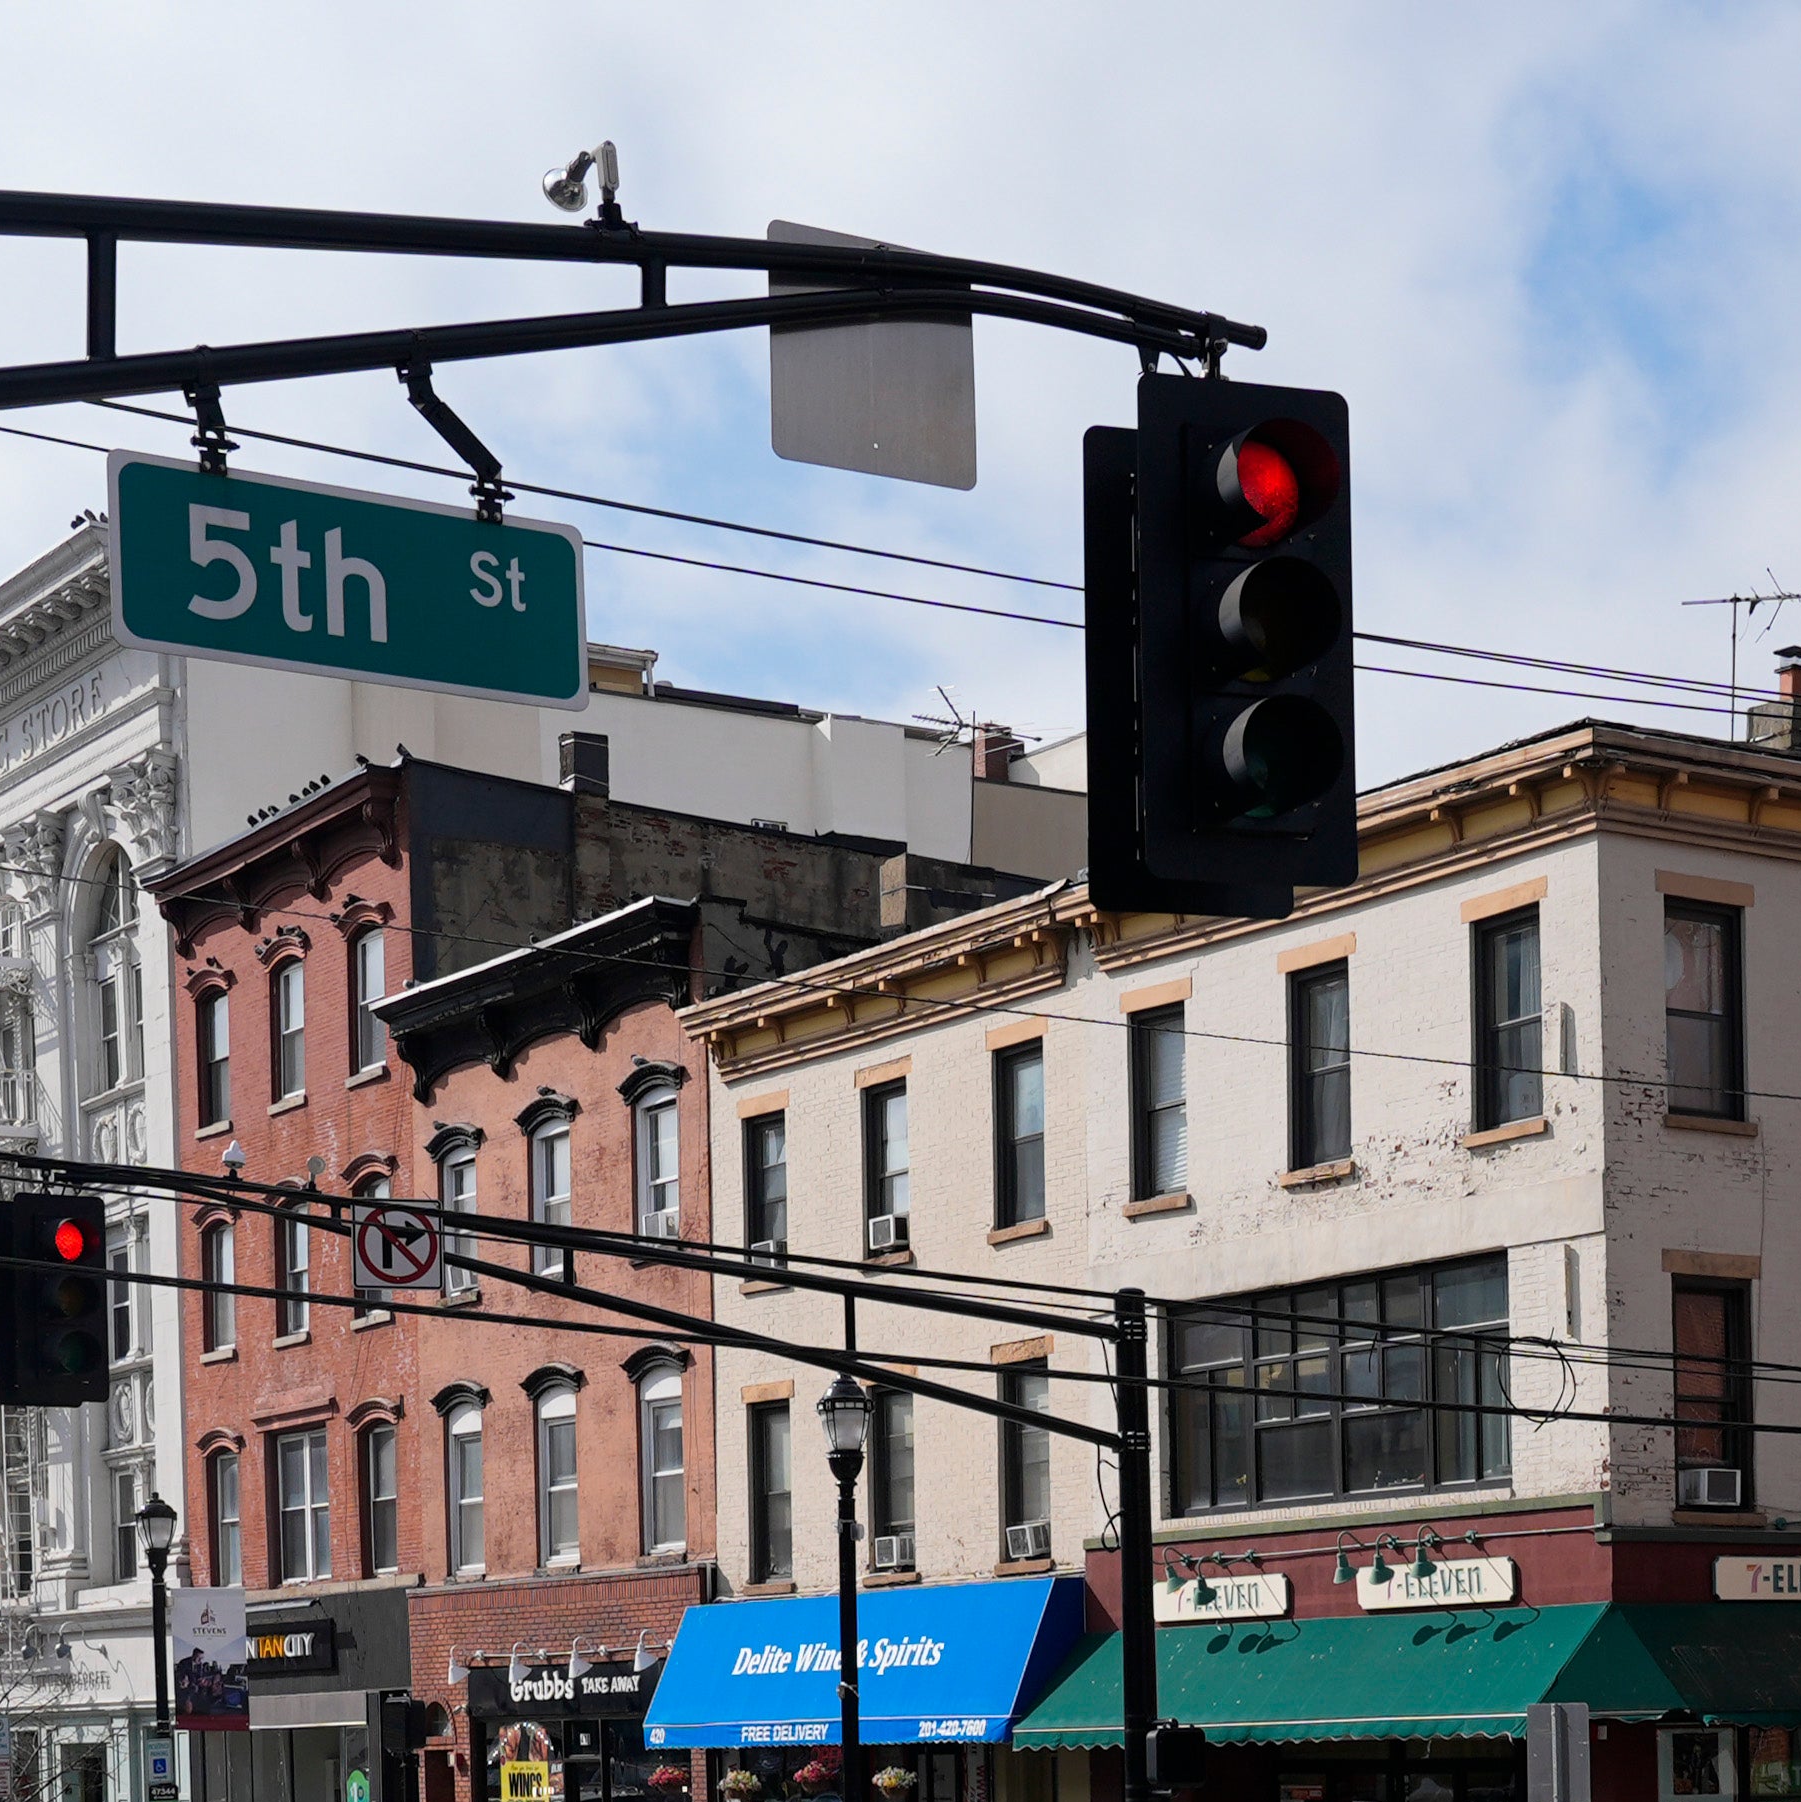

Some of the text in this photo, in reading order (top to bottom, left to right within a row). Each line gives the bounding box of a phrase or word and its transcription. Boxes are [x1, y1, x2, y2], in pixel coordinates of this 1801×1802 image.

[187, 503, 527, 643] 5th St
[22, 670, 109, 762] STORE
[284, 1632, 315, 1658] CITY
[731, 1644, 794, 1676] Delite
[869, 1635, 945, 1676] Spirits
[510, 1670, 640, 1703] Grubbs TAKE AWAY
[649, 1728, 665, 1744] 420
[741, 1723, 829, 1742] FREE DELIVERY
